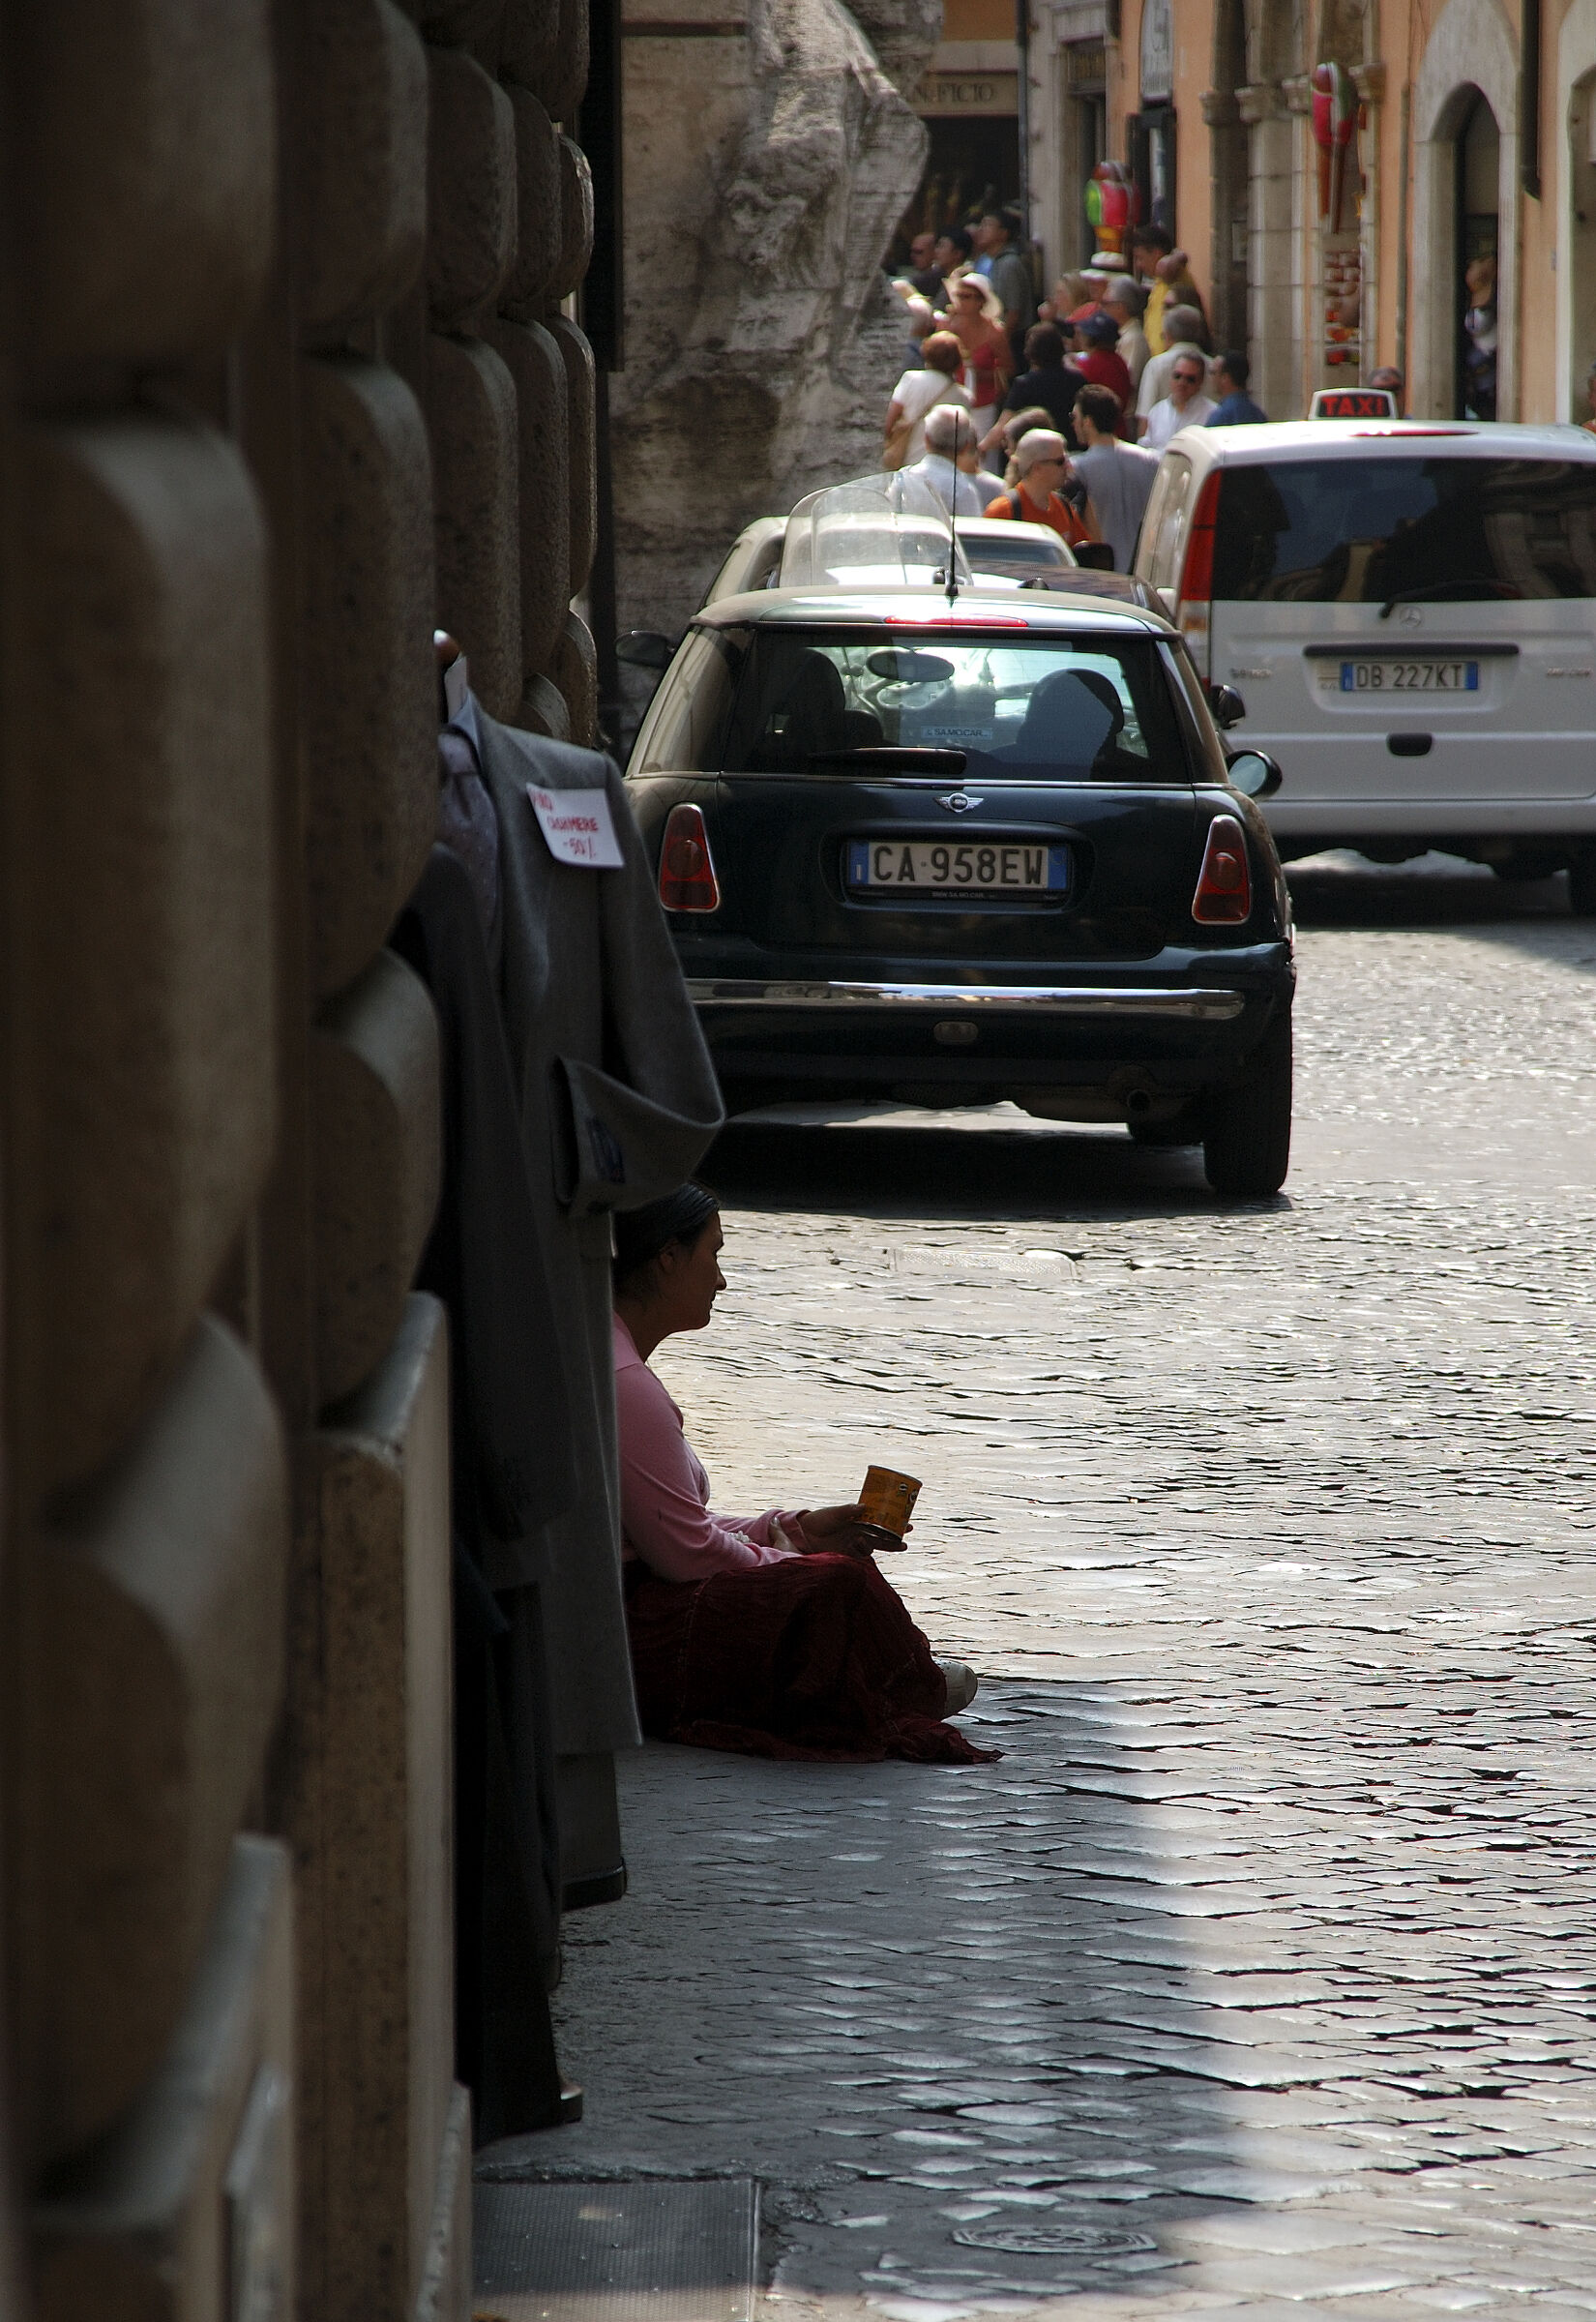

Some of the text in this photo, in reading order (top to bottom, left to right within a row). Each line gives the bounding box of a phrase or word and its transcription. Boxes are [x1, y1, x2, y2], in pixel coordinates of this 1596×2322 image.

[1321, 397, 1383, 416] TAXI
[1357, 665, 1462, 687] DB 227KT
[874, 846, 1043, 884] CA 958EW
